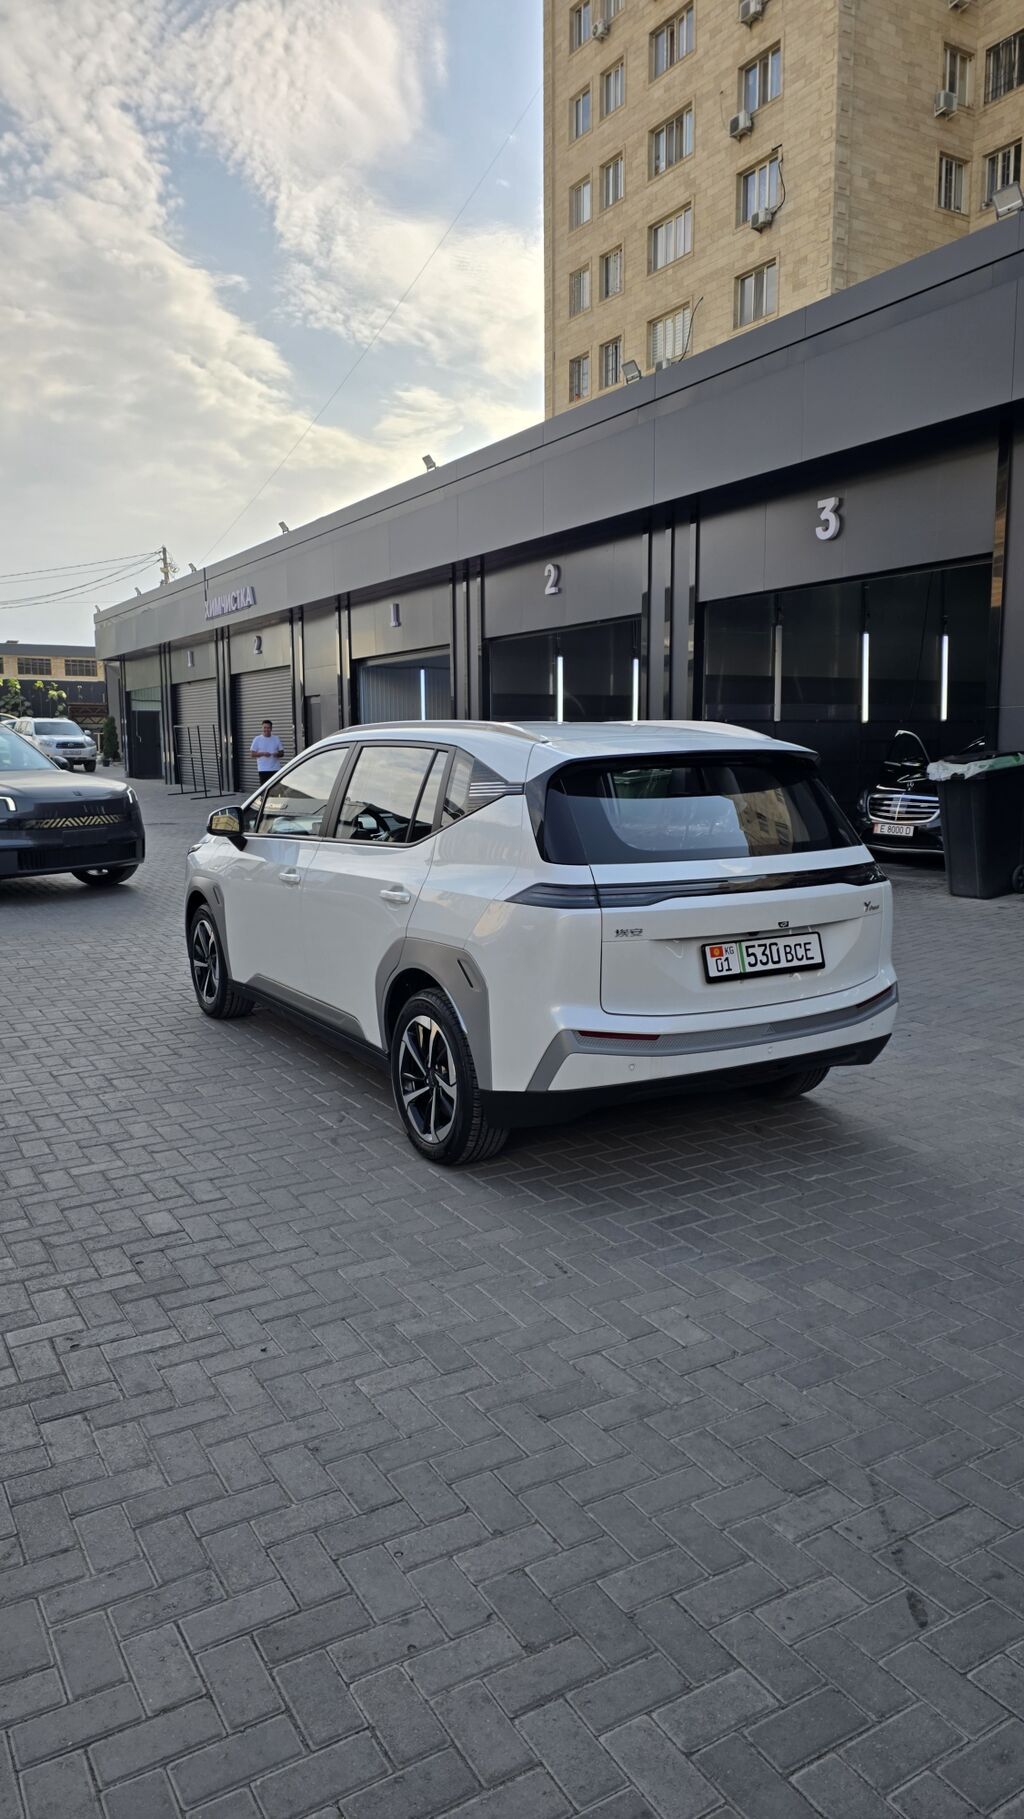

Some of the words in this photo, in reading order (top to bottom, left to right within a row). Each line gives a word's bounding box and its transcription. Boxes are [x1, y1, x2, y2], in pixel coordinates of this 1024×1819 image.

[815, 496, 842, 541] 3
[544, 563, 561, 595] 2
[204, 586, 256, 620] ХИМЧИСТКА
[390, 603, 401, 627] 1
[253, 635, 263, 654] 2
[725, 946, 735, 955] KG
[745, 942, 781, 967] 530
[715, 957, 733, 972] 01
